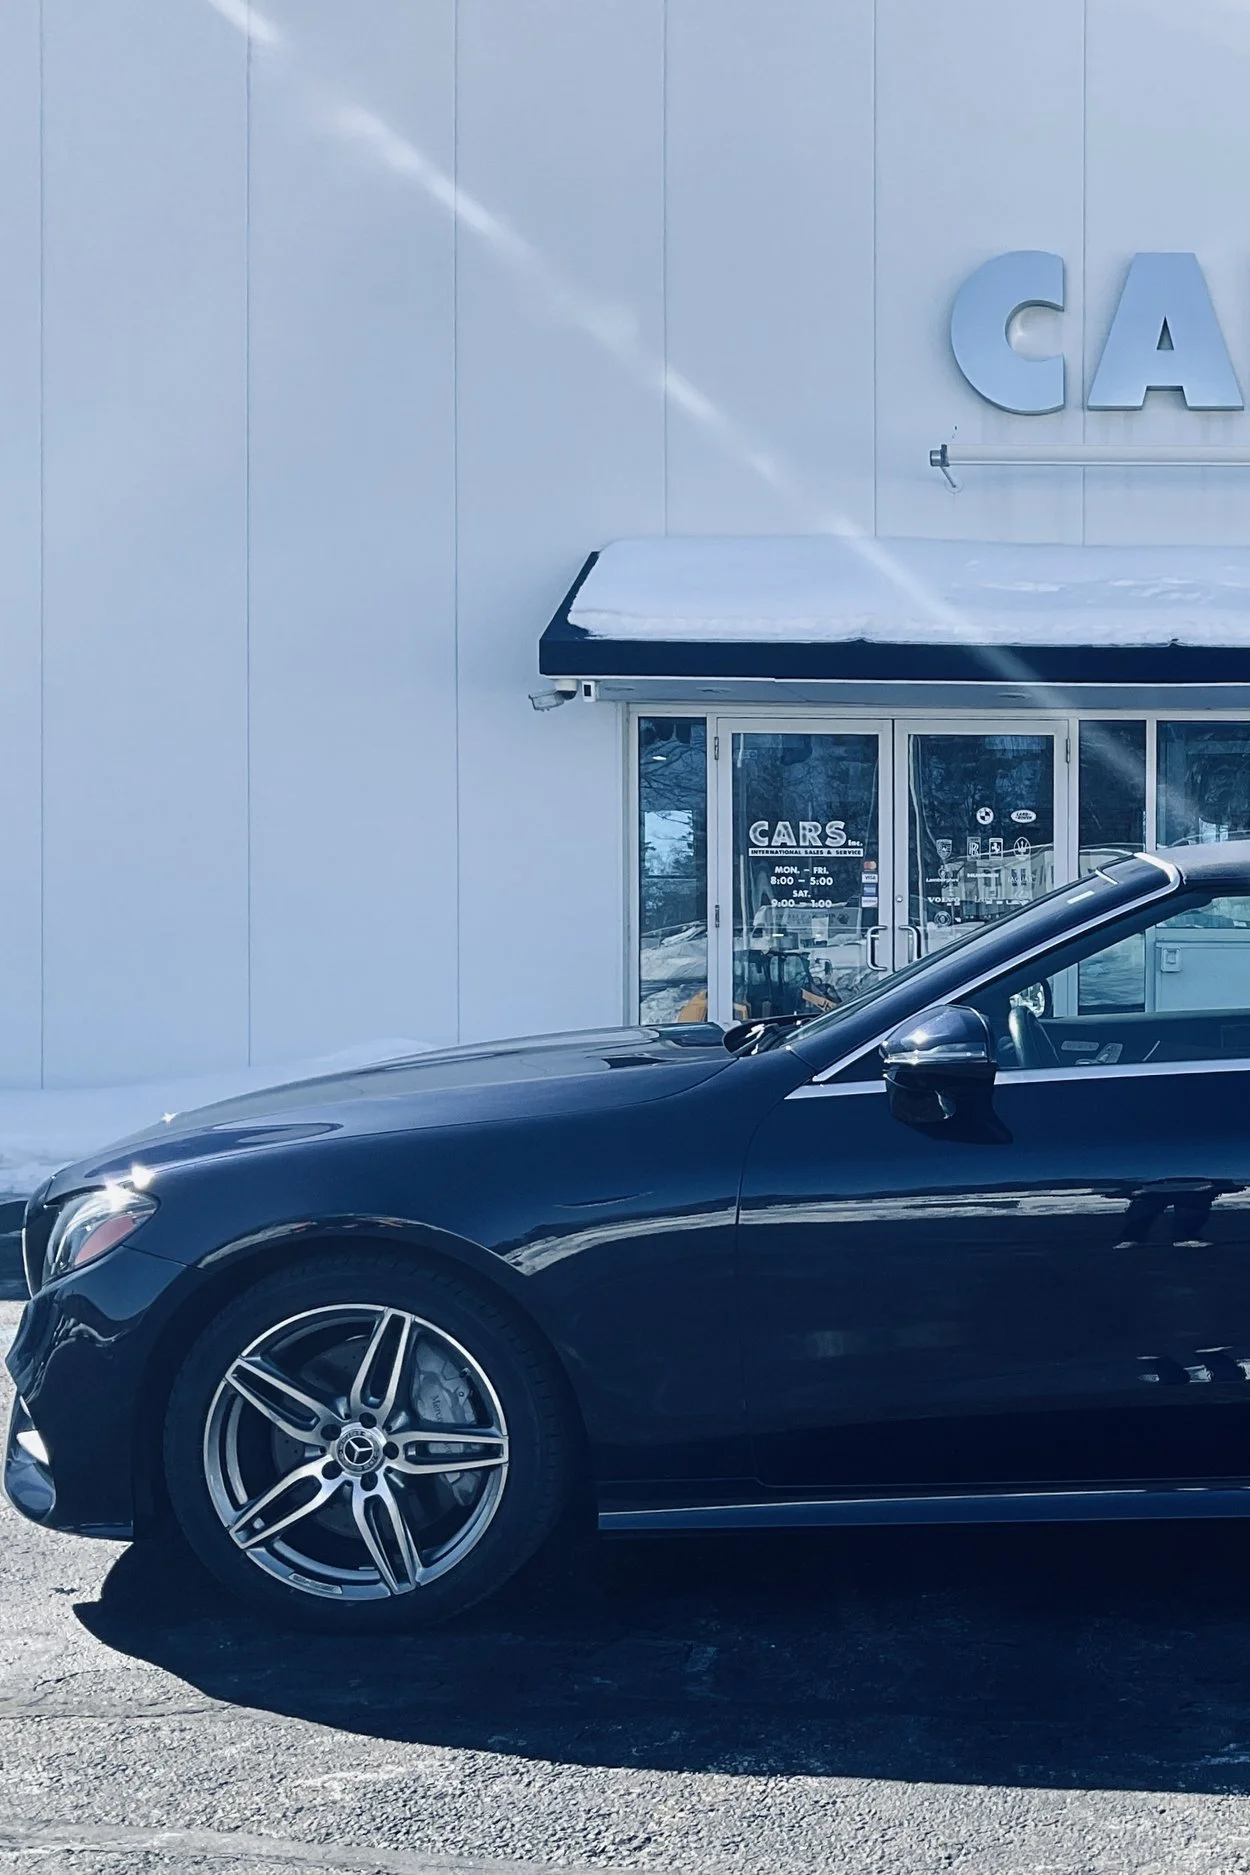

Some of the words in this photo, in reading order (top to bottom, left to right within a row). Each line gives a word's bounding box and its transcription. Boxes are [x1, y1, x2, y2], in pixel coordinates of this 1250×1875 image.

[749, 820, 847, 847] CARS
[774, 866, 800, 874] MON.
[813, 866, 829, 874] FRI.
[770, 876, 794, 885] 8:00
[810, 877, 833, 886] 5:00
[792, 890, 811, 898] SAT.
[771, 900, 795, 908] 9:00
[810, 900, 832, 908] 1:00
